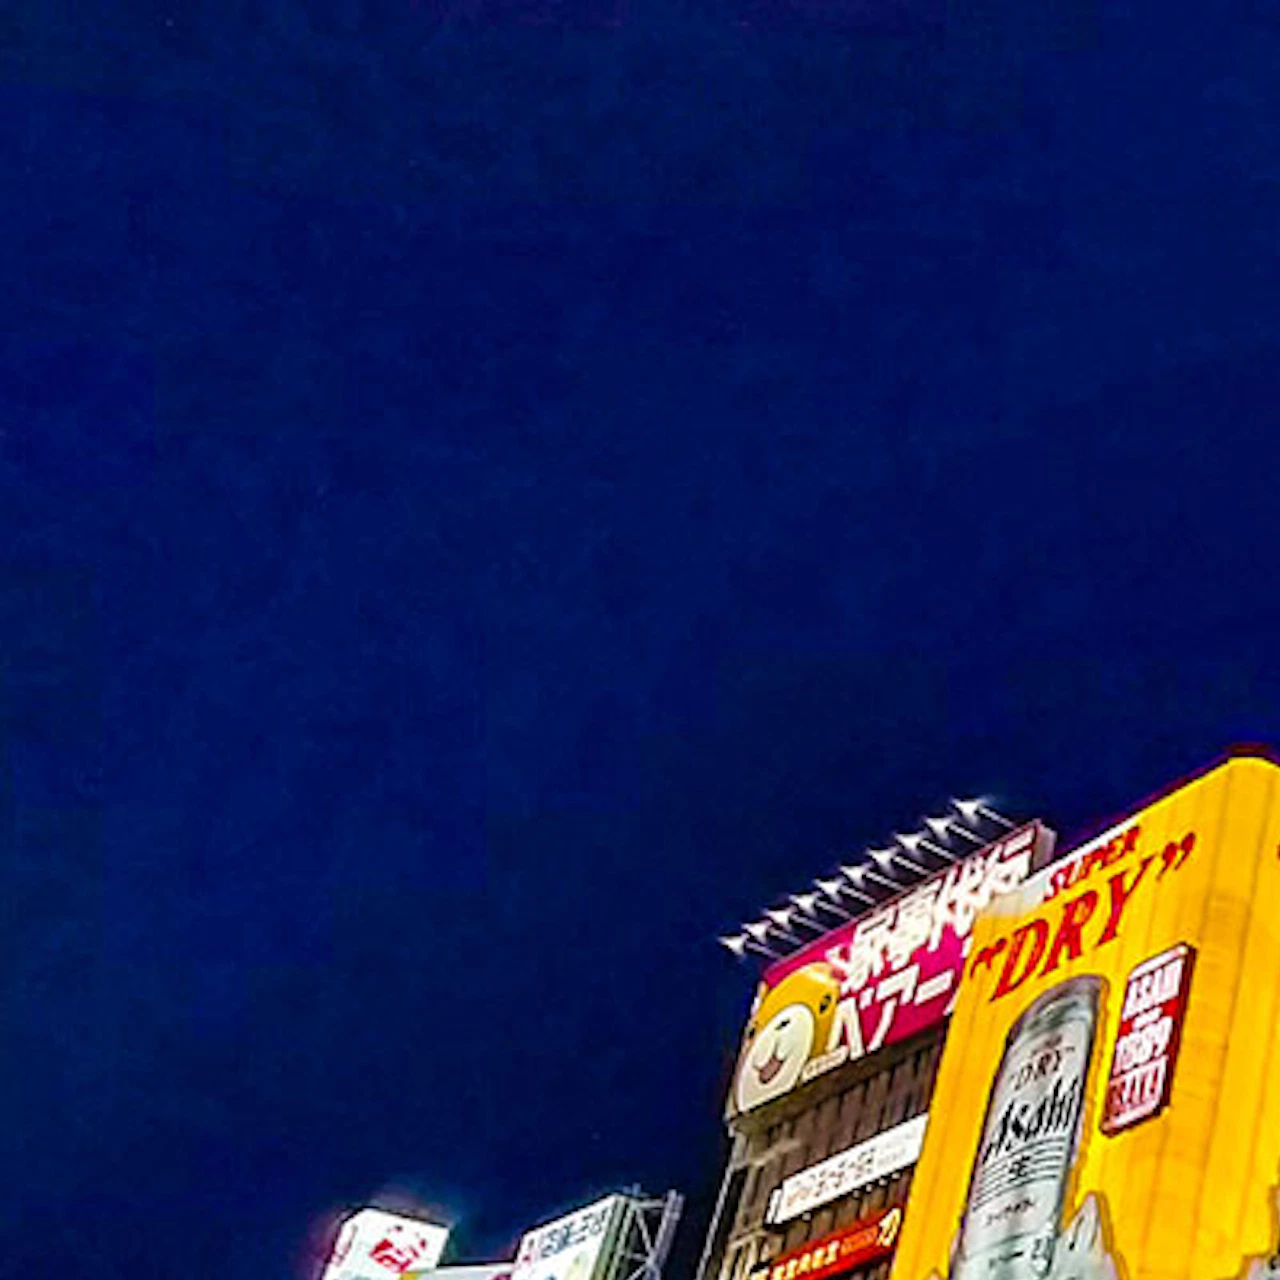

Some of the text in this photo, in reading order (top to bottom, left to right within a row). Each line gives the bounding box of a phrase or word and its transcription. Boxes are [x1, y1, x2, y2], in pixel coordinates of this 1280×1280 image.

[1044, 826, 1141, 901] SUPER
[826, 963, 962, 1061] ベアー
